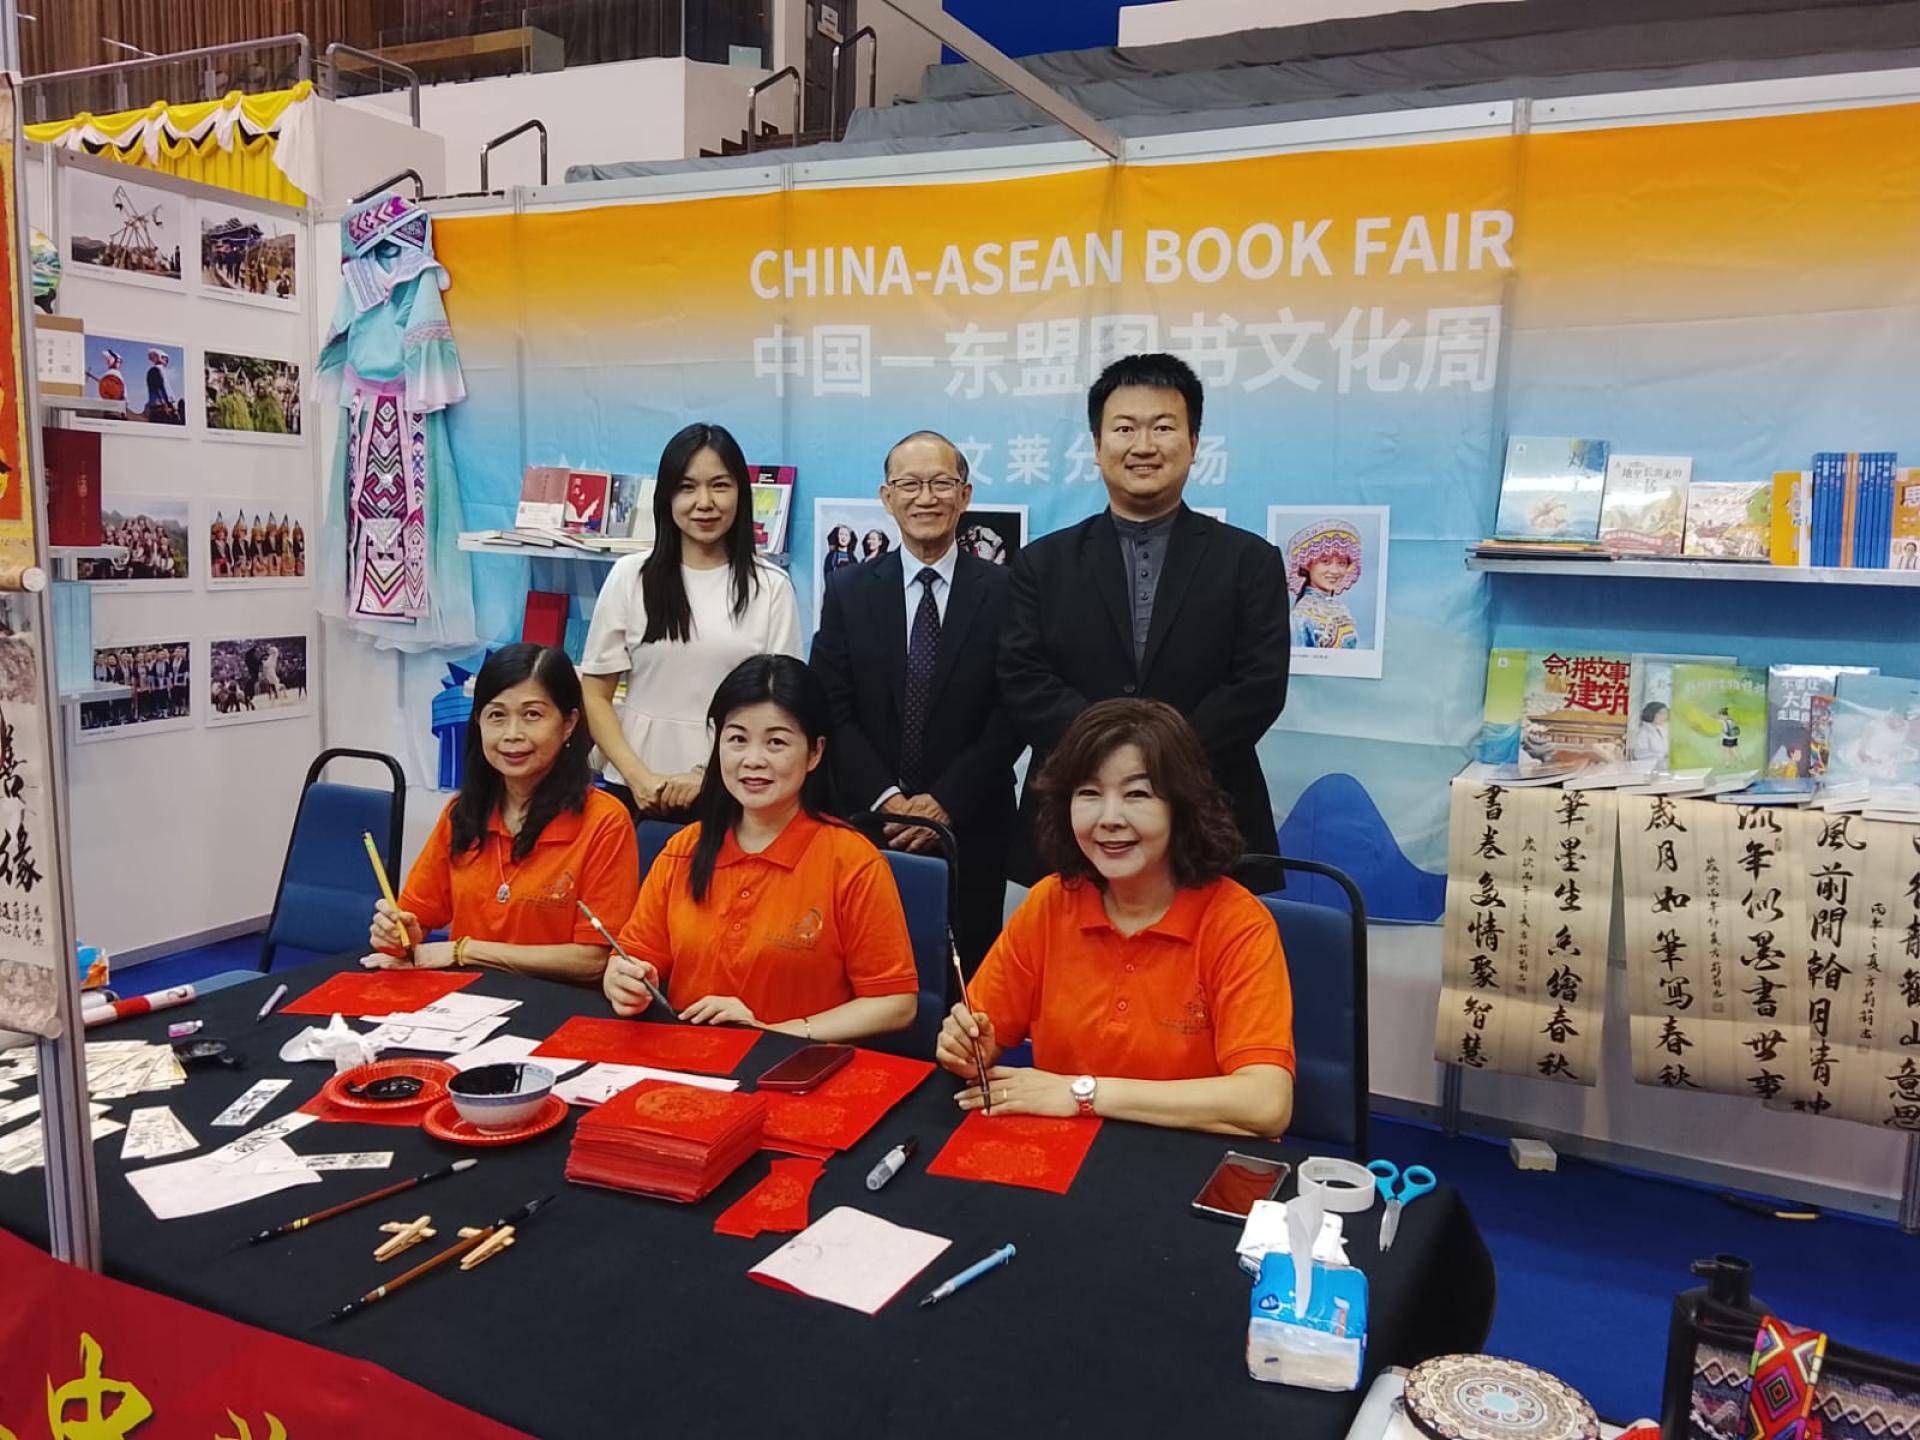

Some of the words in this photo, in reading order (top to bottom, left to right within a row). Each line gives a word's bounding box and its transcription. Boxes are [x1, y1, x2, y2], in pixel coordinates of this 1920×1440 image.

[750, 229, 1124, 301] CHINA-ASEAN
[1145, 218, 1334, 284] BOOK
[1354, 209, 1515, 276] FAIR
